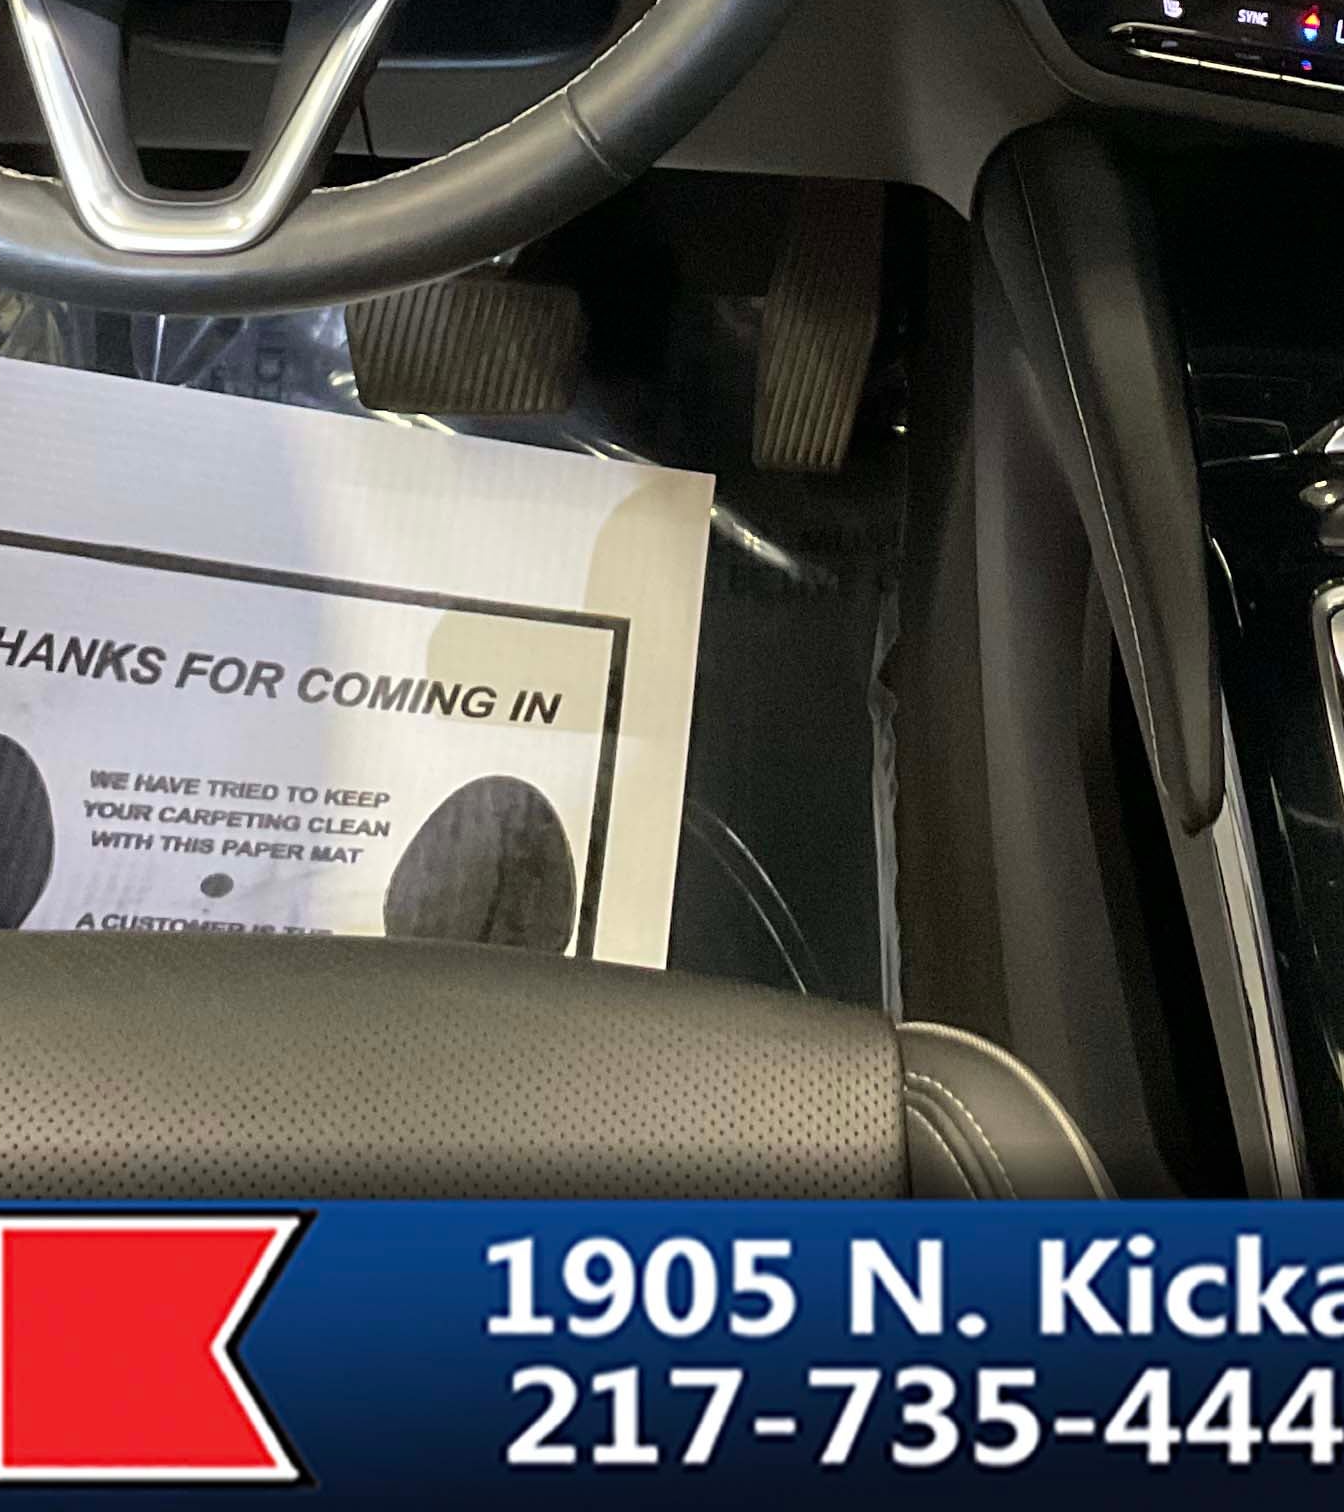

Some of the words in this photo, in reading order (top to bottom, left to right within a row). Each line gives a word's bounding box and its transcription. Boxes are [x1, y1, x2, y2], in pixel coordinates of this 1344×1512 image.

[1237, 9, 1268, 27] SYNC
[174, 652, 286, 700] FOR
[297, 668, 498, 719] COMING
[508, 691, 563, 726] IN
[90, 769, 129, 789] WE
[134, 773, 200, 796] HAVE
[208, 779, 278, 801] TRIED
[288, 786, 318, 804] TO
[323, 789, 390, 808] KEEP
[83, 800, 153, 822] YOUR
[158, 805, 300, 832] CARPETING
[307, 817, 391, 838] CLEAN
[91, 831, 154, 851] WITH
[160, 835, 214, 854] THIS
[221, 840, 304, 861] PAPER
[310, 845, 363, 864] MAT
